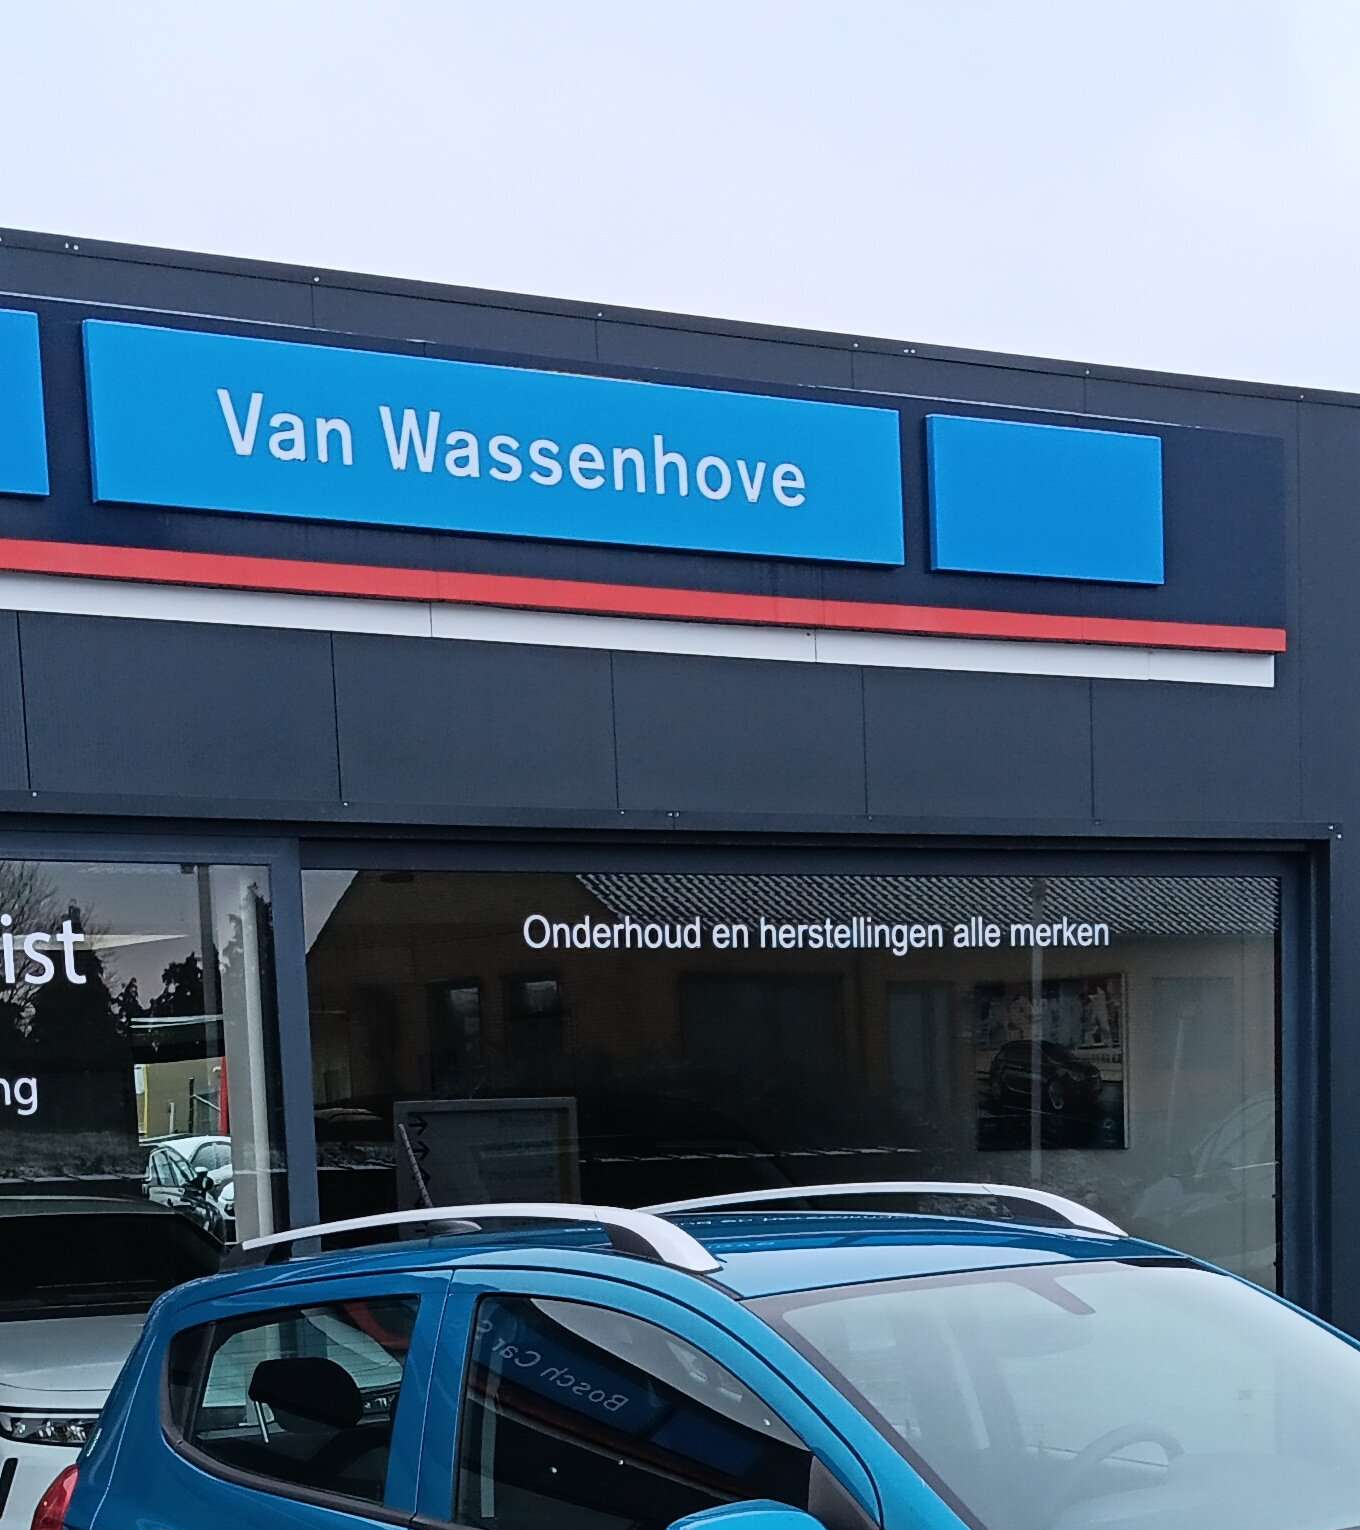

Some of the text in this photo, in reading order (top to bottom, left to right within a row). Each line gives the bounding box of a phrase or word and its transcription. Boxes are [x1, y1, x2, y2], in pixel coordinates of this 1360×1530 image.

[217, 388, 807, 507] Van Wassenhove
[523, 914, 1110, 957] Onderhoud en herstellingen alle merken
